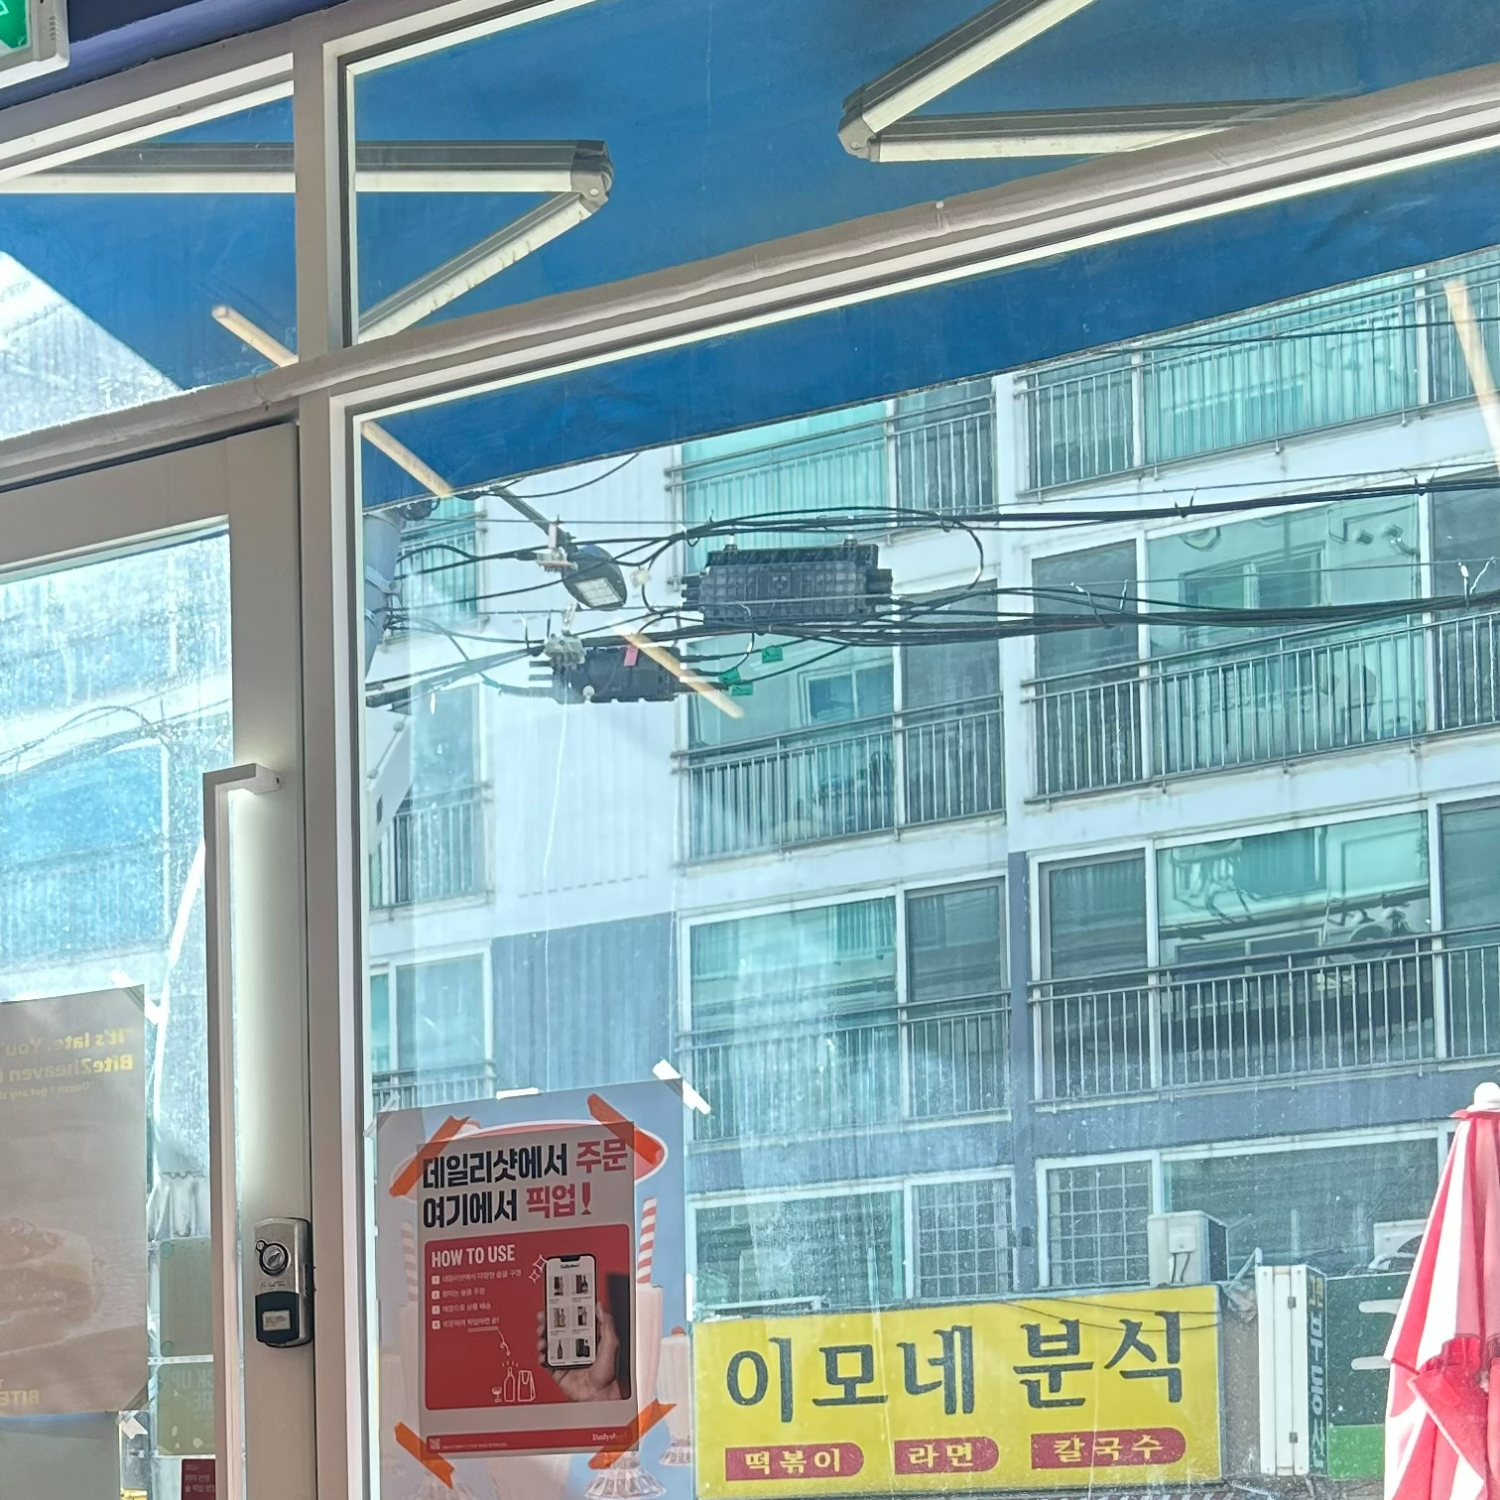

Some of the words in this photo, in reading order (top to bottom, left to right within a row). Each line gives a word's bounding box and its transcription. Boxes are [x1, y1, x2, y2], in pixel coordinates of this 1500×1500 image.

[423, 1143, 568, 1190] 데일리샷에서
[576, 1138, 629, 1174] 주문
[423, 1189, 518, 1228] 여기에서
[526, 1182, 592, 1217] 픽업!
[431, 1249, 465, 1268] HOW
[467, 1247, 484, 1265] TO
[488, 1244, 516, 1263] USE
[725, 1325, 976, 1424] 이모네
[1012, 1311, 1184, 1409] 분식
[744, 1448, 841, 1476] 떡볶이
[907, 1442, 975, 1470] 라면
[1053, 1433, 1165, 1464] 칼국수
